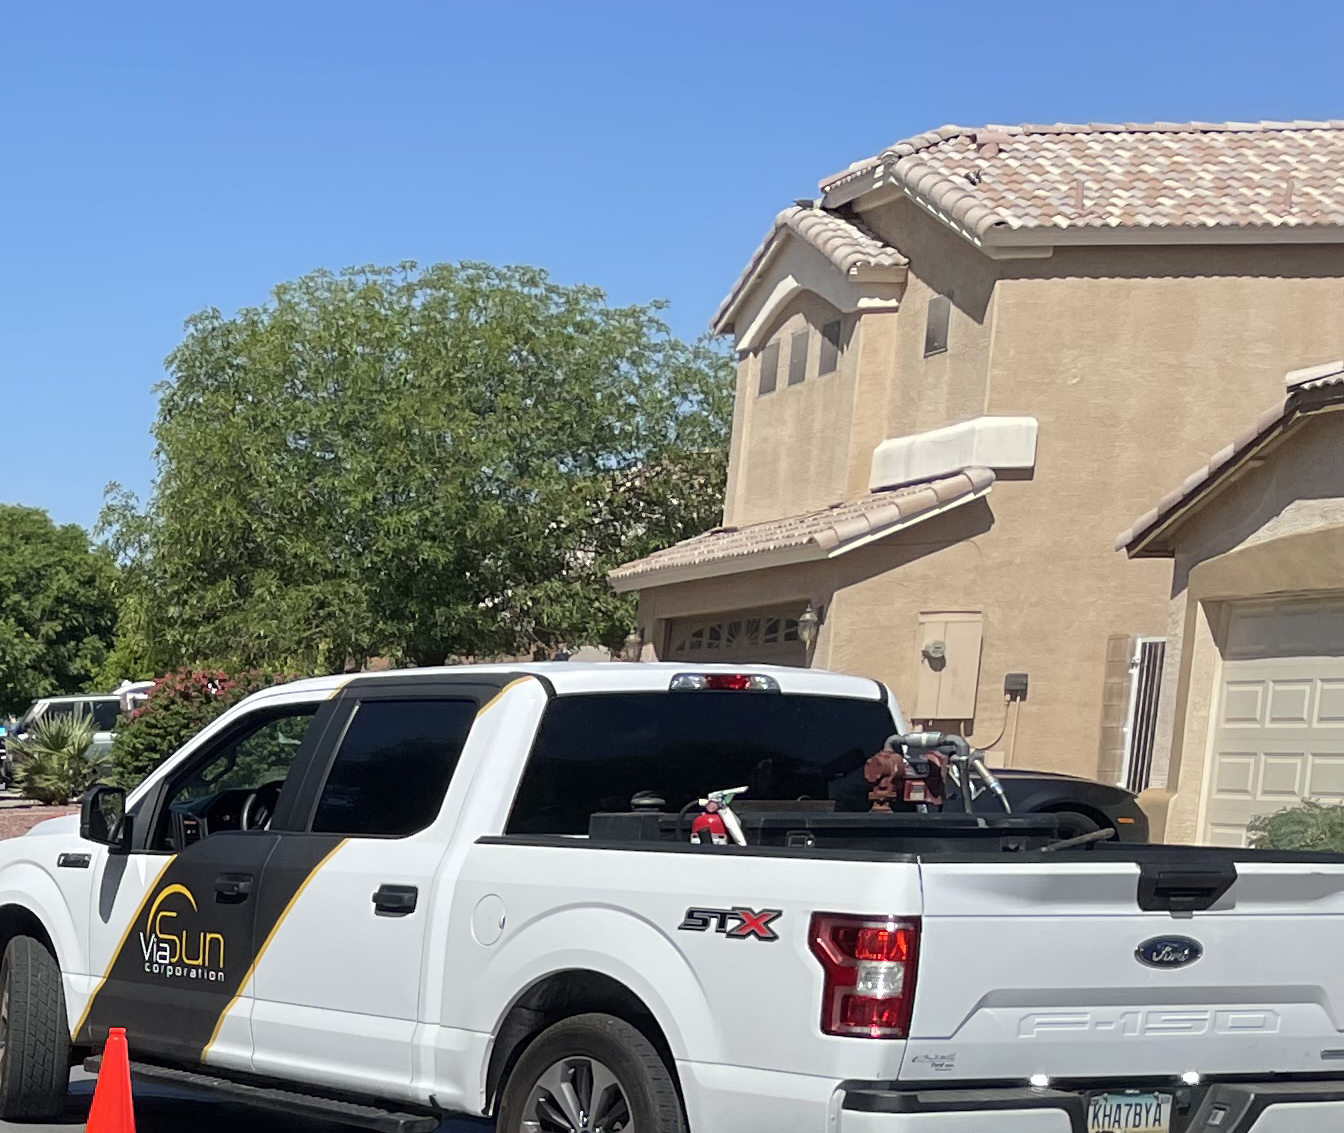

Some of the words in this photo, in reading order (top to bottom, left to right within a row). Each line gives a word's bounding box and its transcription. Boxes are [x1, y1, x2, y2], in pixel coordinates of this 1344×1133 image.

[678, 906, 783, 942] STX
[139, 910, 224, 969] ViaSun
[144, 962, 225, 981] corporation
[1017, 1009, 1281, 1038] F-150
[1092, 1102, 1162, 1130] KHA7BYA
